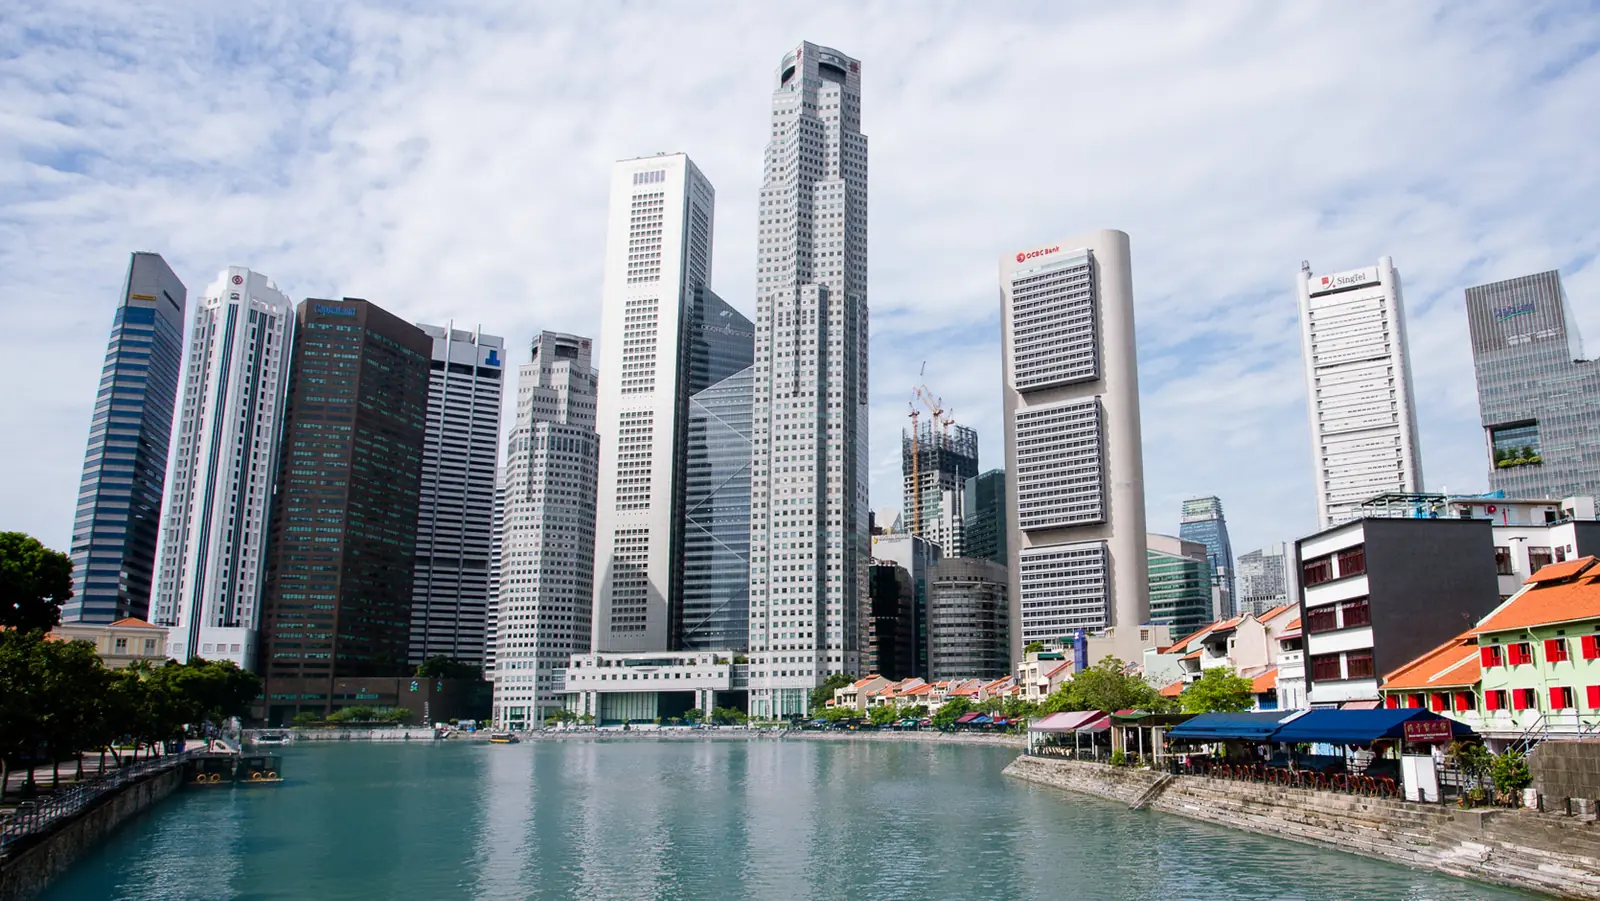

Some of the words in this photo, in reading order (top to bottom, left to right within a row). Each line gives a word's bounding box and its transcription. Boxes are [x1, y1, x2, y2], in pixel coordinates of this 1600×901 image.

[1026, 249, 1044, 259] OCBC
[1045, 245, 1060, 255] Bank
[1337, 273, 1366, 285] SingTel
